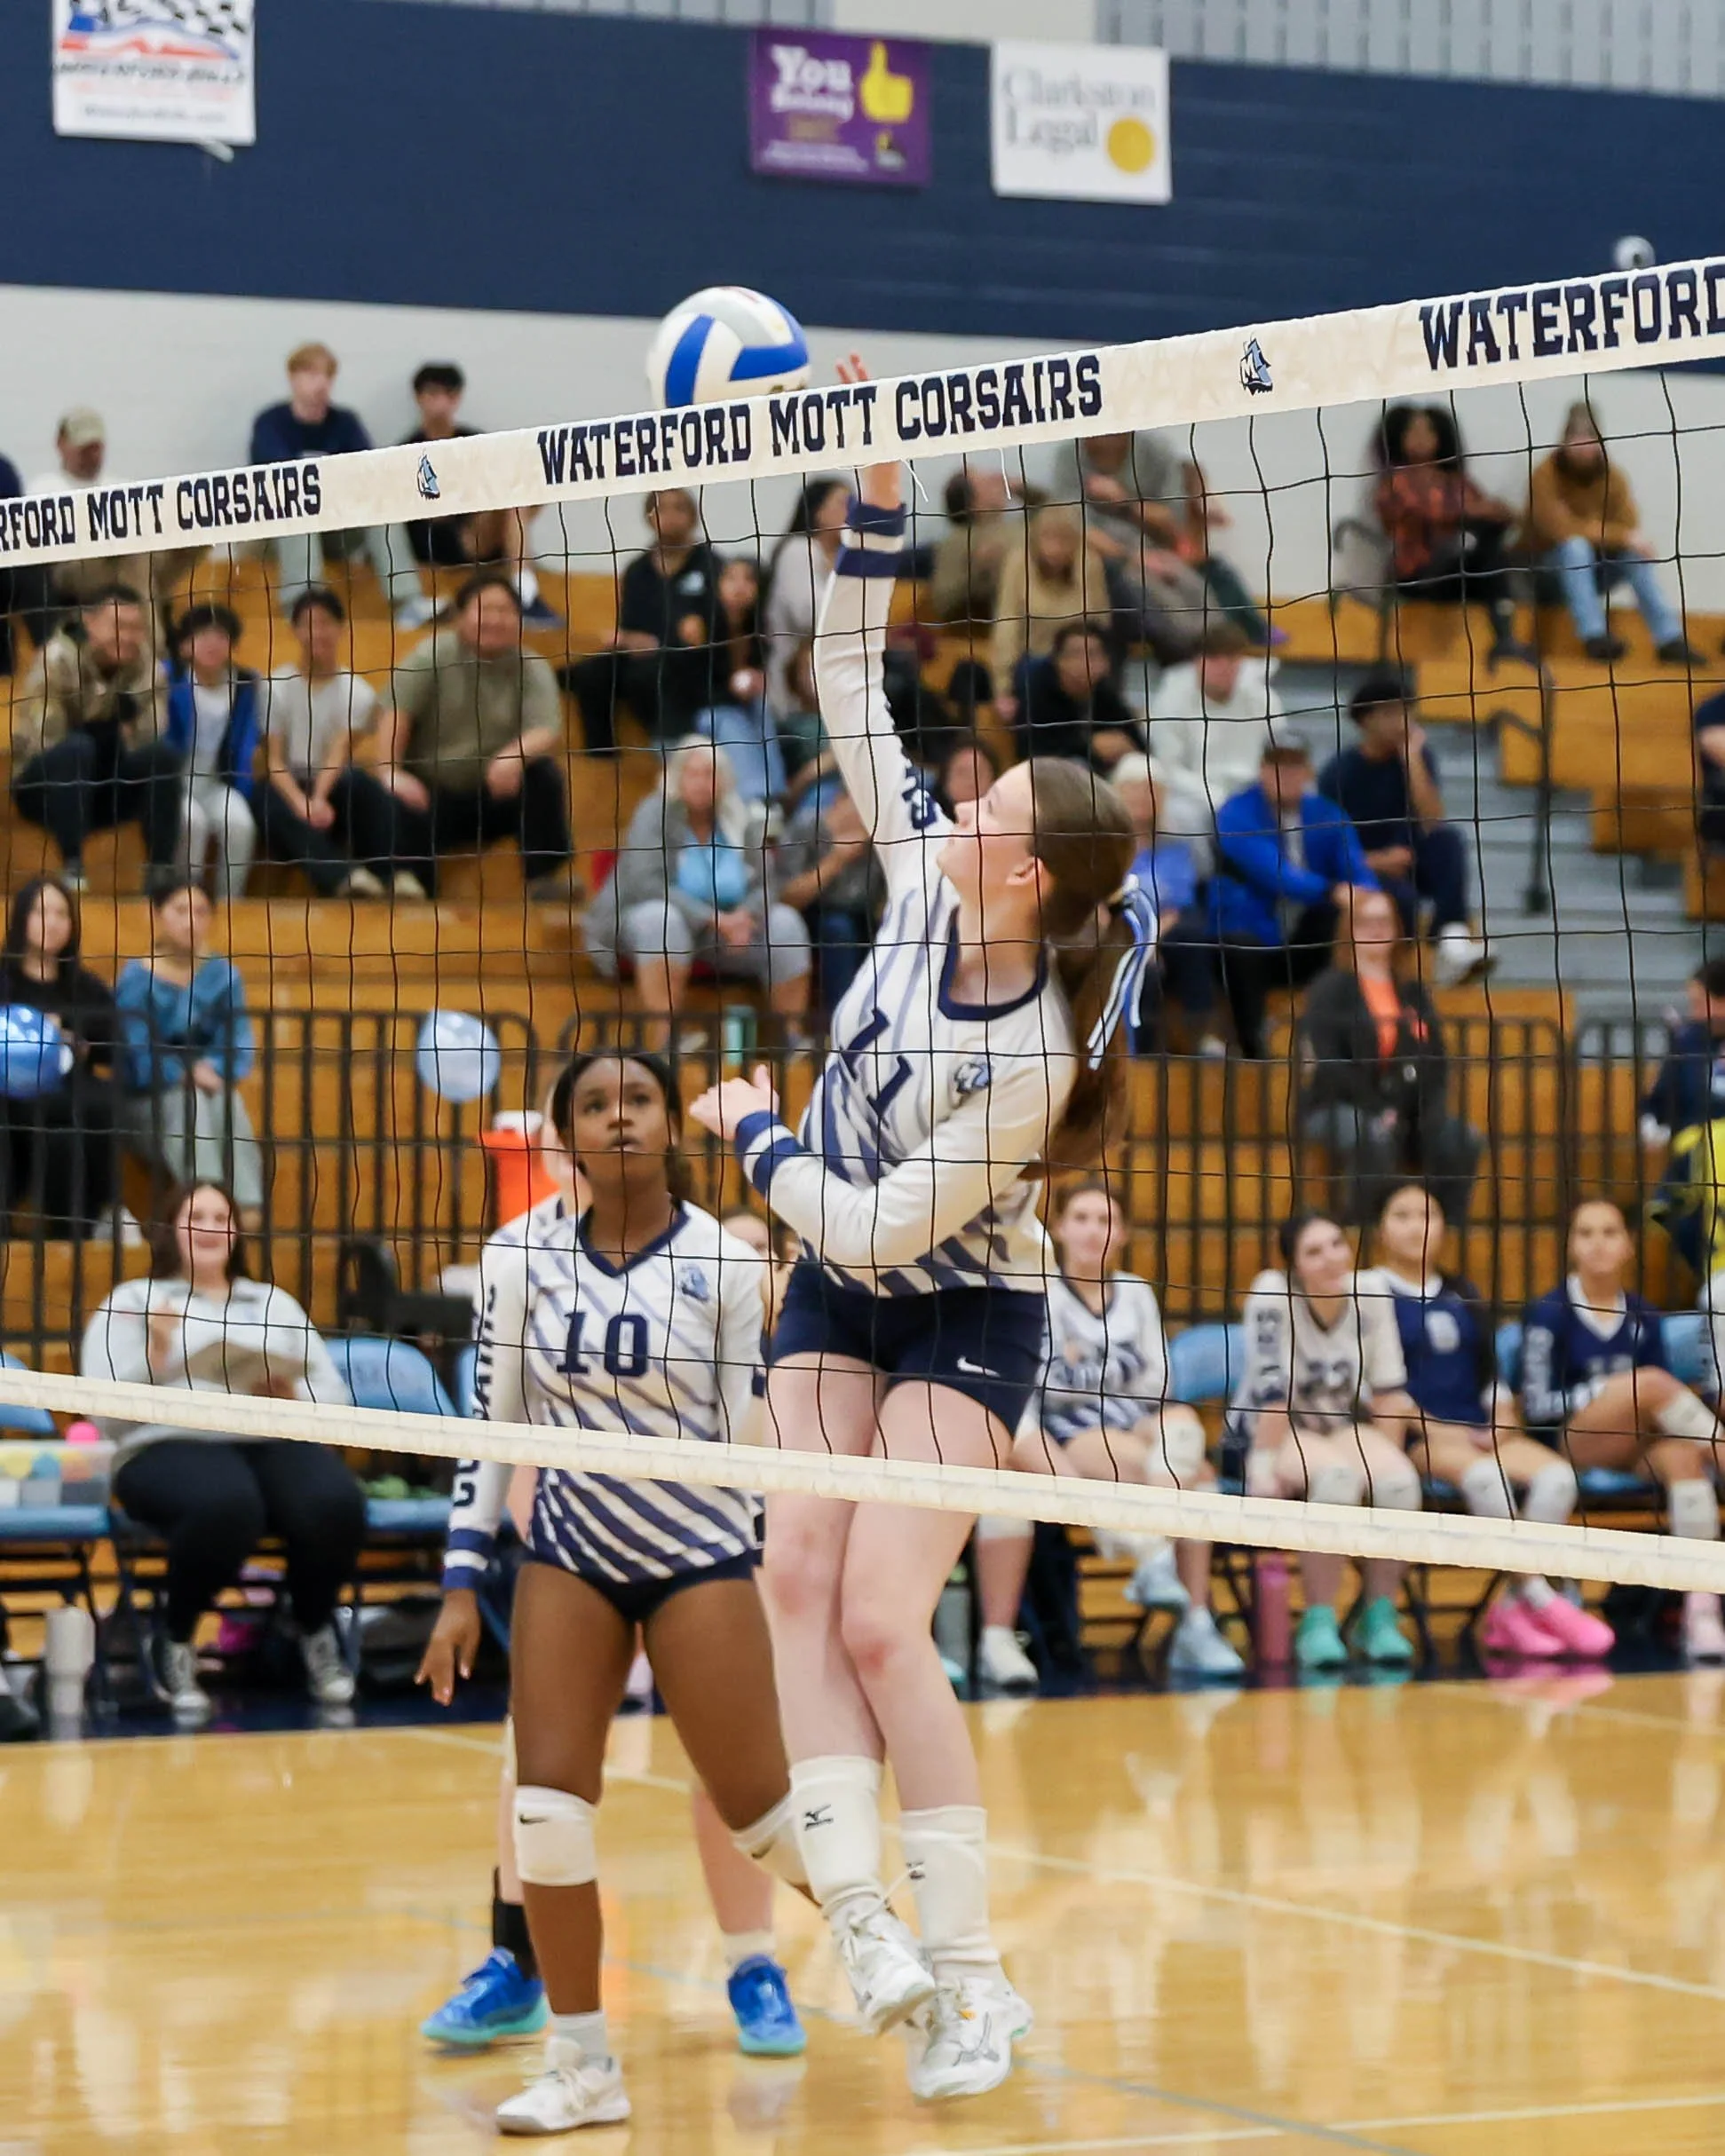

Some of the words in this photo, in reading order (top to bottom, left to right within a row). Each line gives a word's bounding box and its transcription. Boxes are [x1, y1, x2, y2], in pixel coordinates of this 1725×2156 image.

[771, 44, 851, 91] You
[1420, 264, 1725, 371] WATERFORD
[537, 403, 752, 485] WATERFORD
[769, 385, 877, 456] MOTT
[896, 355, 1103, 441] CORSAIRS
[87, 485, 163, 541] MOTT
[177, 464, 321, 531] CORSAIRS
[557, 1311, 648, 1378] 10
